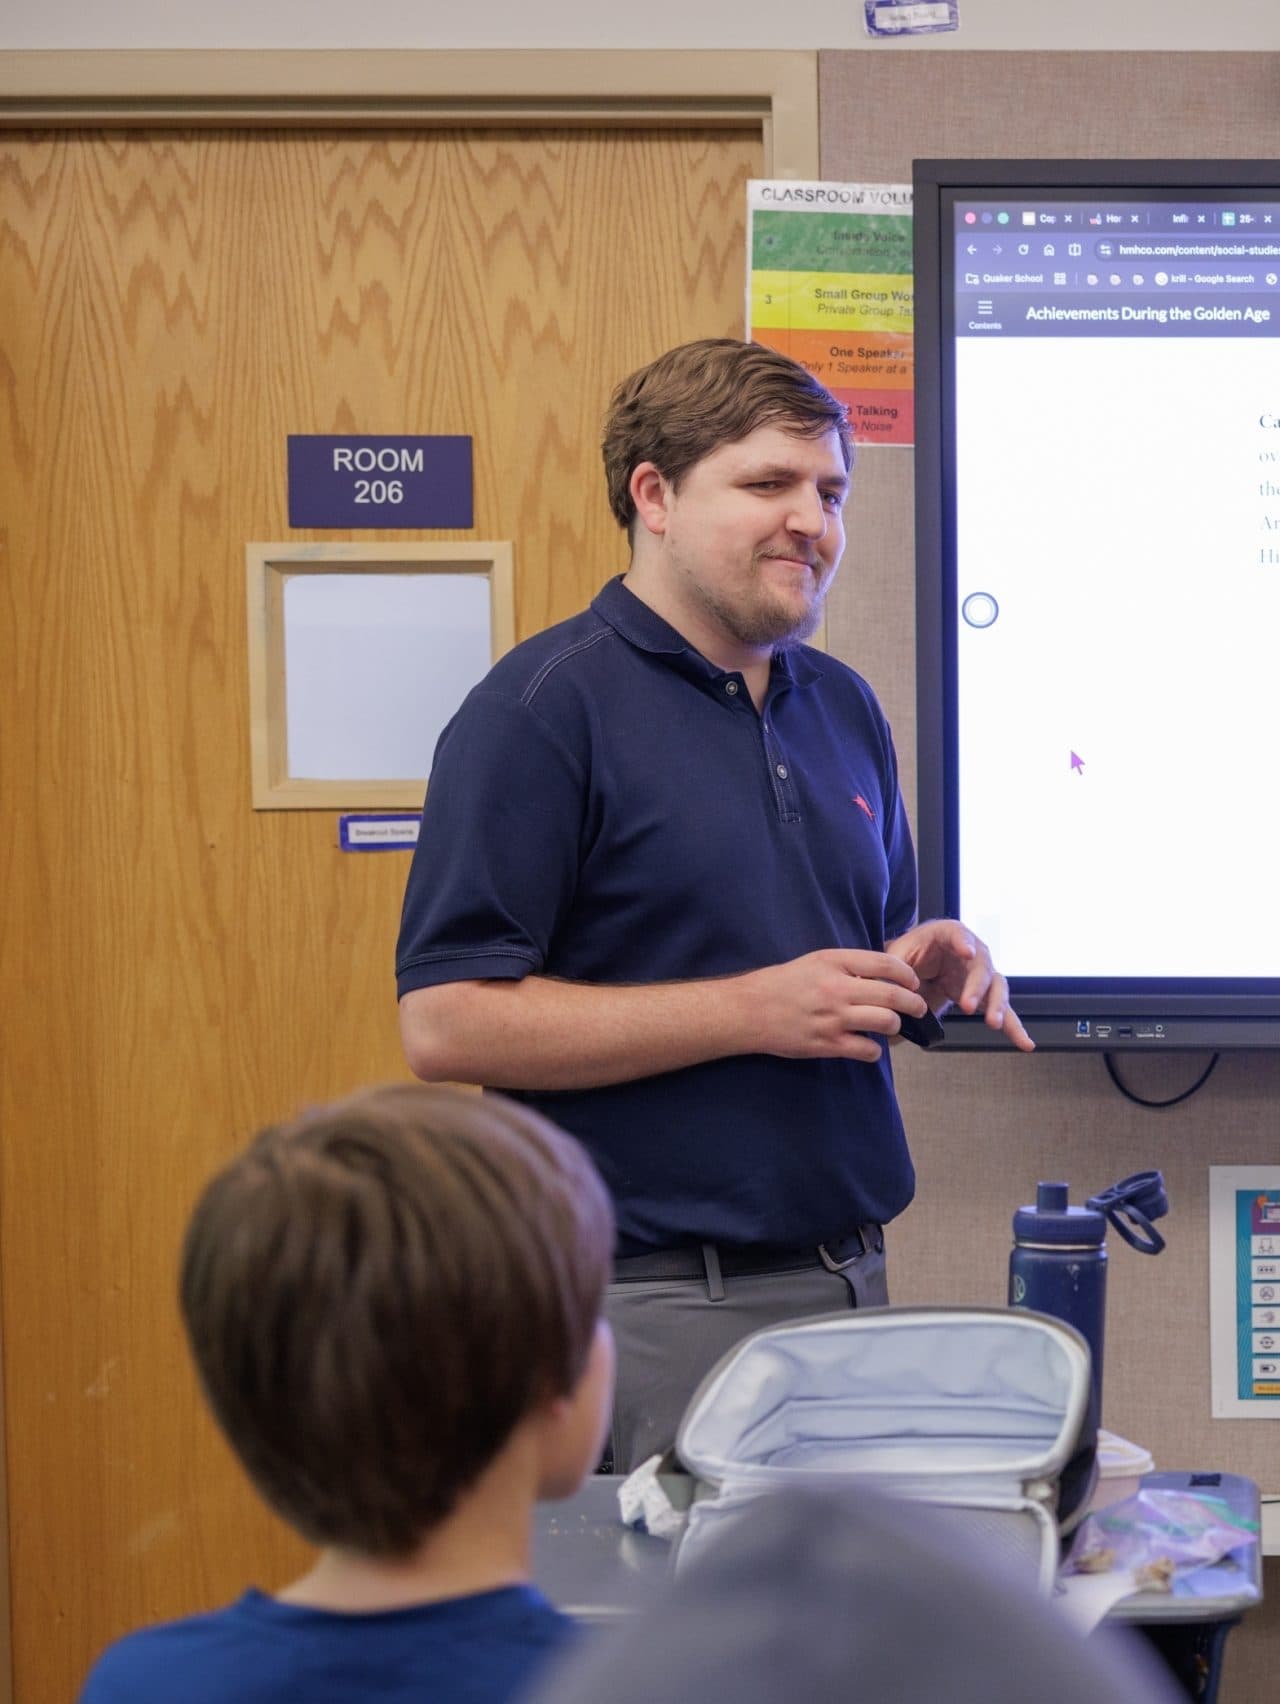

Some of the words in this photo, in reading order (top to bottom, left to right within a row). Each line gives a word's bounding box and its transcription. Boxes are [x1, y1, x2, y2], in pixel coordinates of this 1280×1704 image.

[762, 187, 865, 204] CLASSROOM
[1015, 273, 1044, 284] School
[1194, 273, 1224, 285] Google
[1226, 273, 1255, 285] Search
[764, 295, 772, 304] 3
[814, 288, 848, 300] Small
[851, 290, 888, 303] Group
[817, 304, 856, 315] Private
[859, 304, 894, 318] Group
[1026, 306, 1119, 320] Achievements
[1122, 307, 1167, 323] During
[1170, 307, 1191, 320] the
[1194, 307, 1241, 320] Golden
[1244, 307, 1271, 323] Age
[968, 321, 1002, 330] Contents
[830, 346, 854, 358] One
[837, 361, 884, 374] Speaker
[886, 364, 897, 374] at
[900, 366, 907, 374] a
[856, 405, 898, 419] Talking
[860, 420, 893, 431] Noise
[333, 448, 424, 473] ROOM
[354, 480, 404, 504] 206
